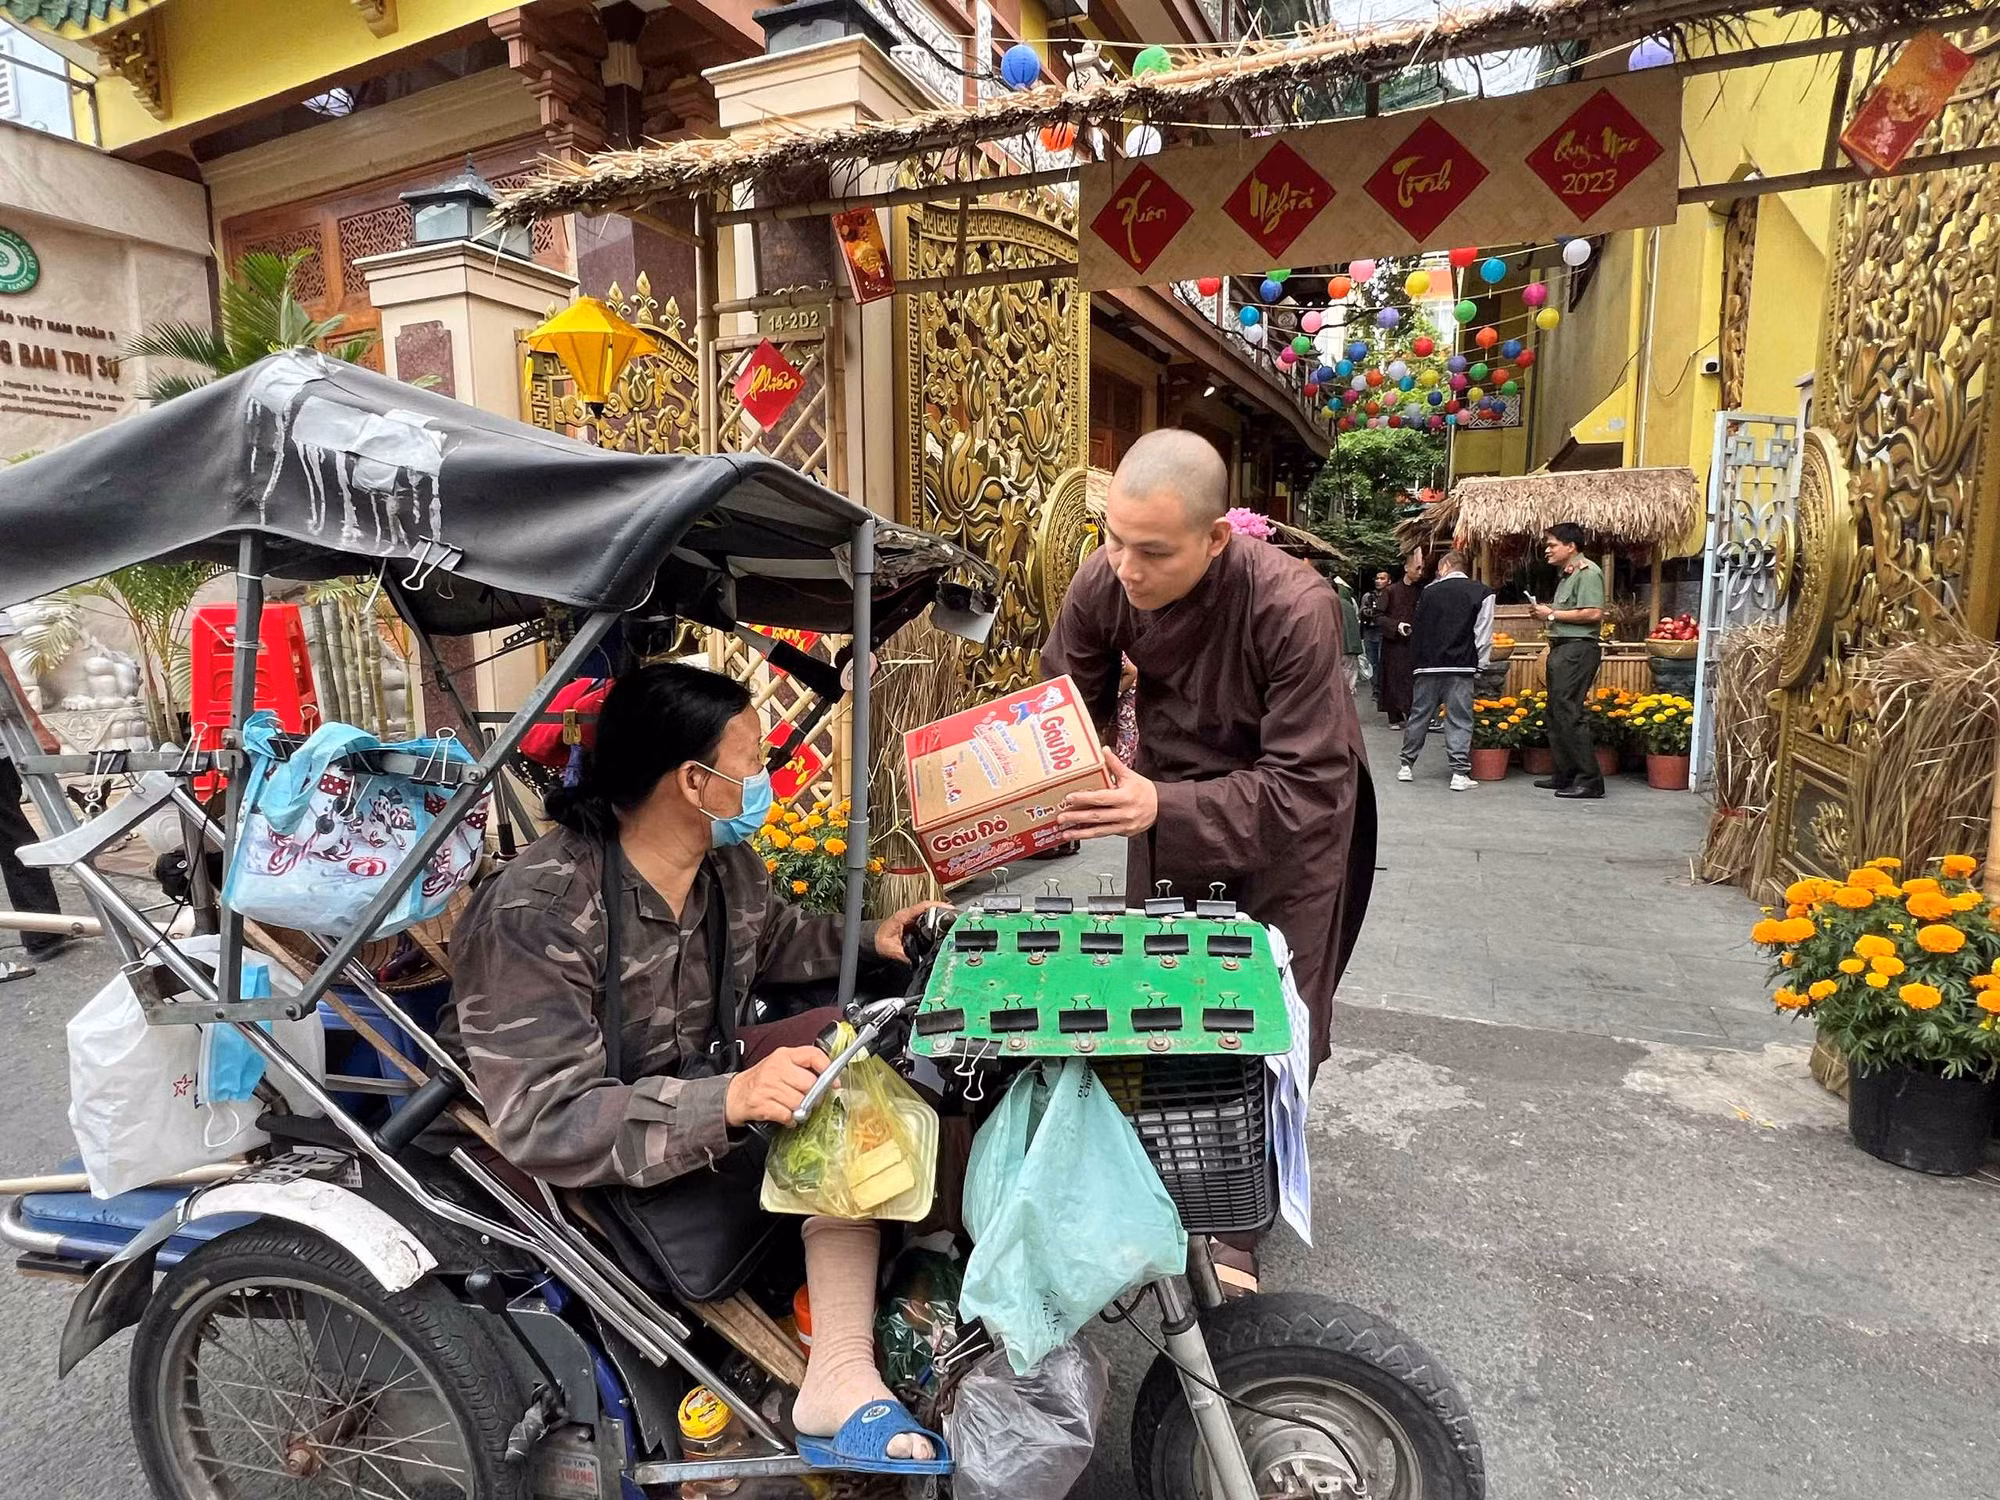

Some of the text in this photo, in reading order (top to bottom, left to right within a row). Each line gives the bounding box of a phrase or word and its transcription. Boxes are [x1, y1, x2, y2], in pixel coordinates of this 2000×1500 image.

[1562, 168, 1617, 195] 2023
[1117, 180, 1167, 264] Xuân
[1250, 171, 1315, 235] Nghĩa
[47, 320, 73, 334] NAM
[768, 311, 820, 331] 14-2D2
[18, 343, 58, 371] BAN
[61, 350, 92, 381] TRỊ
[1026, 805, 1054, 820] Tôm
[932, 828, 978, 853] Gấu
[976, 816, 1009, 839] Đỏ
